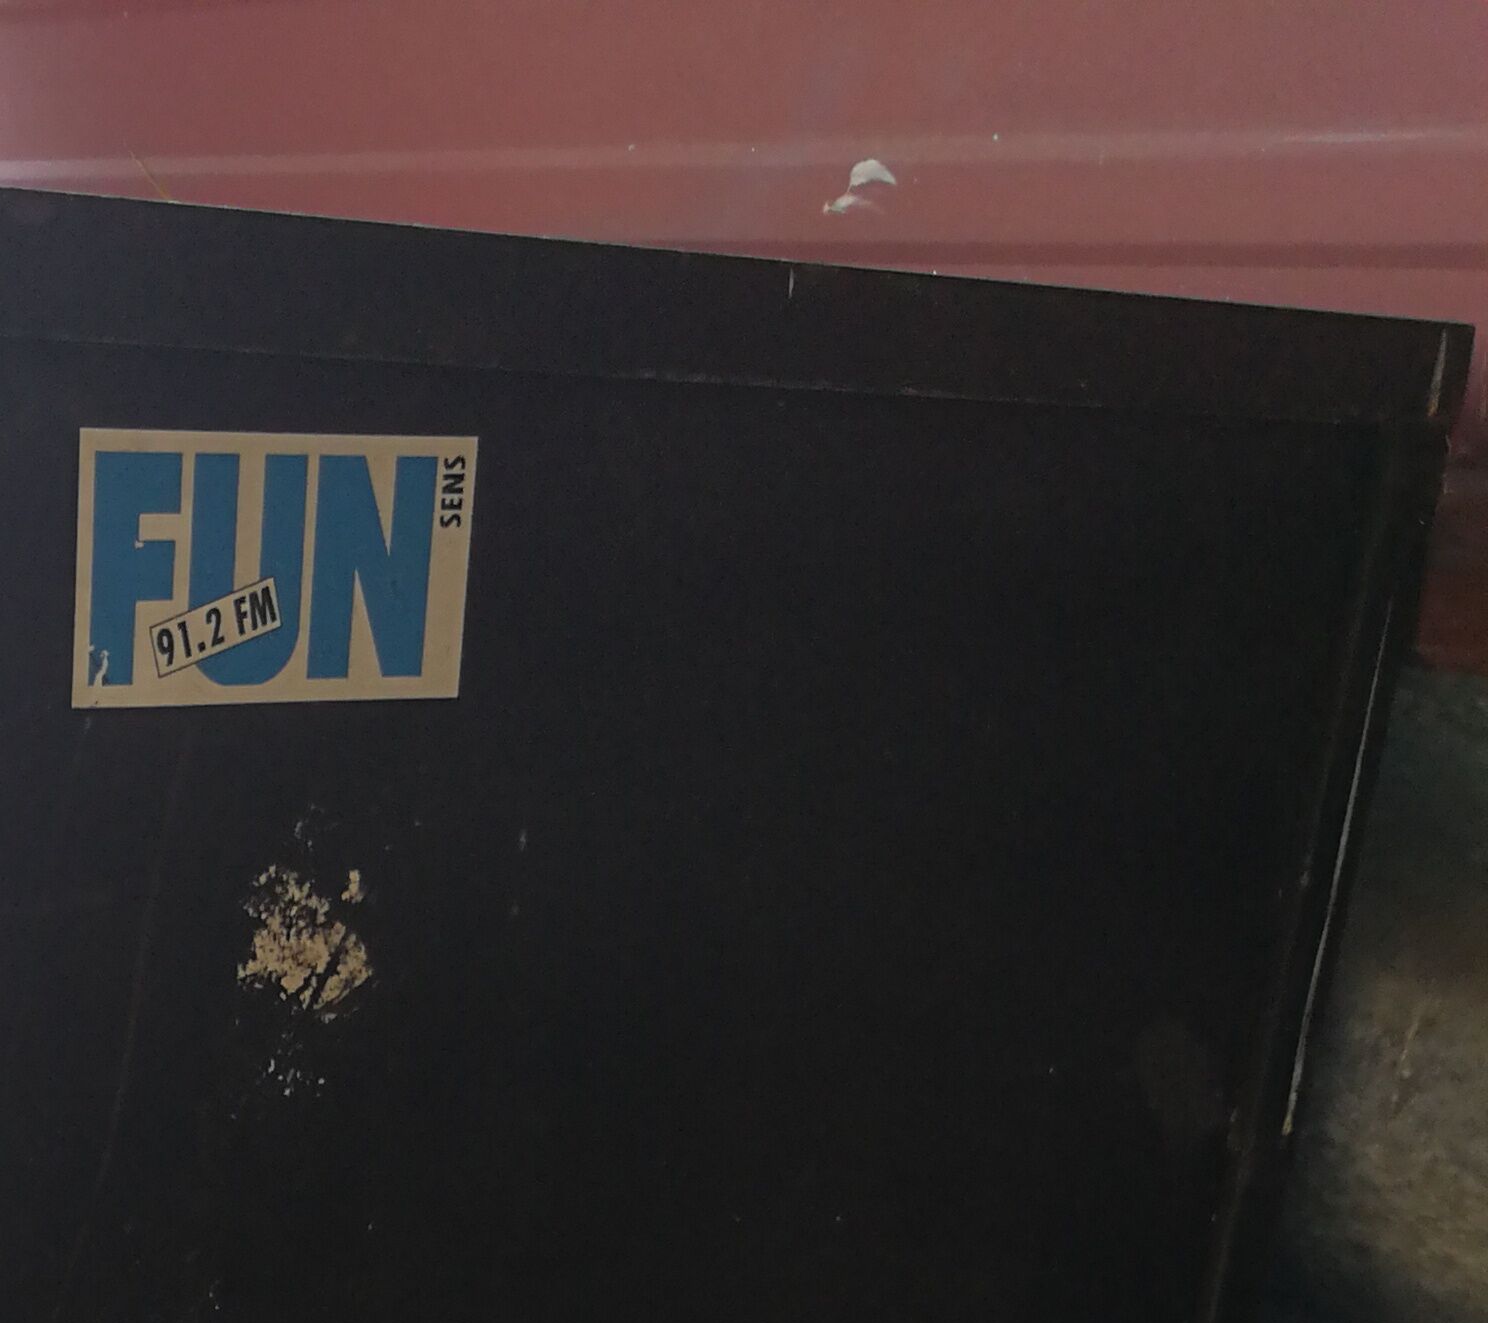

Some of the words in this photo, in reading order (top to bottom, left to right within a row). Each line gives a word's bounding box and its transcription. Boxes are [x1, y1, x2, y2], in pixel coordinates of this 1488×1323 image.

[440, 455, 466, 528] SENS
[88, 451, 438, 687] FUN
[156, 608, 225, 667] 91.2
[233, 586, 278, 637] FM
